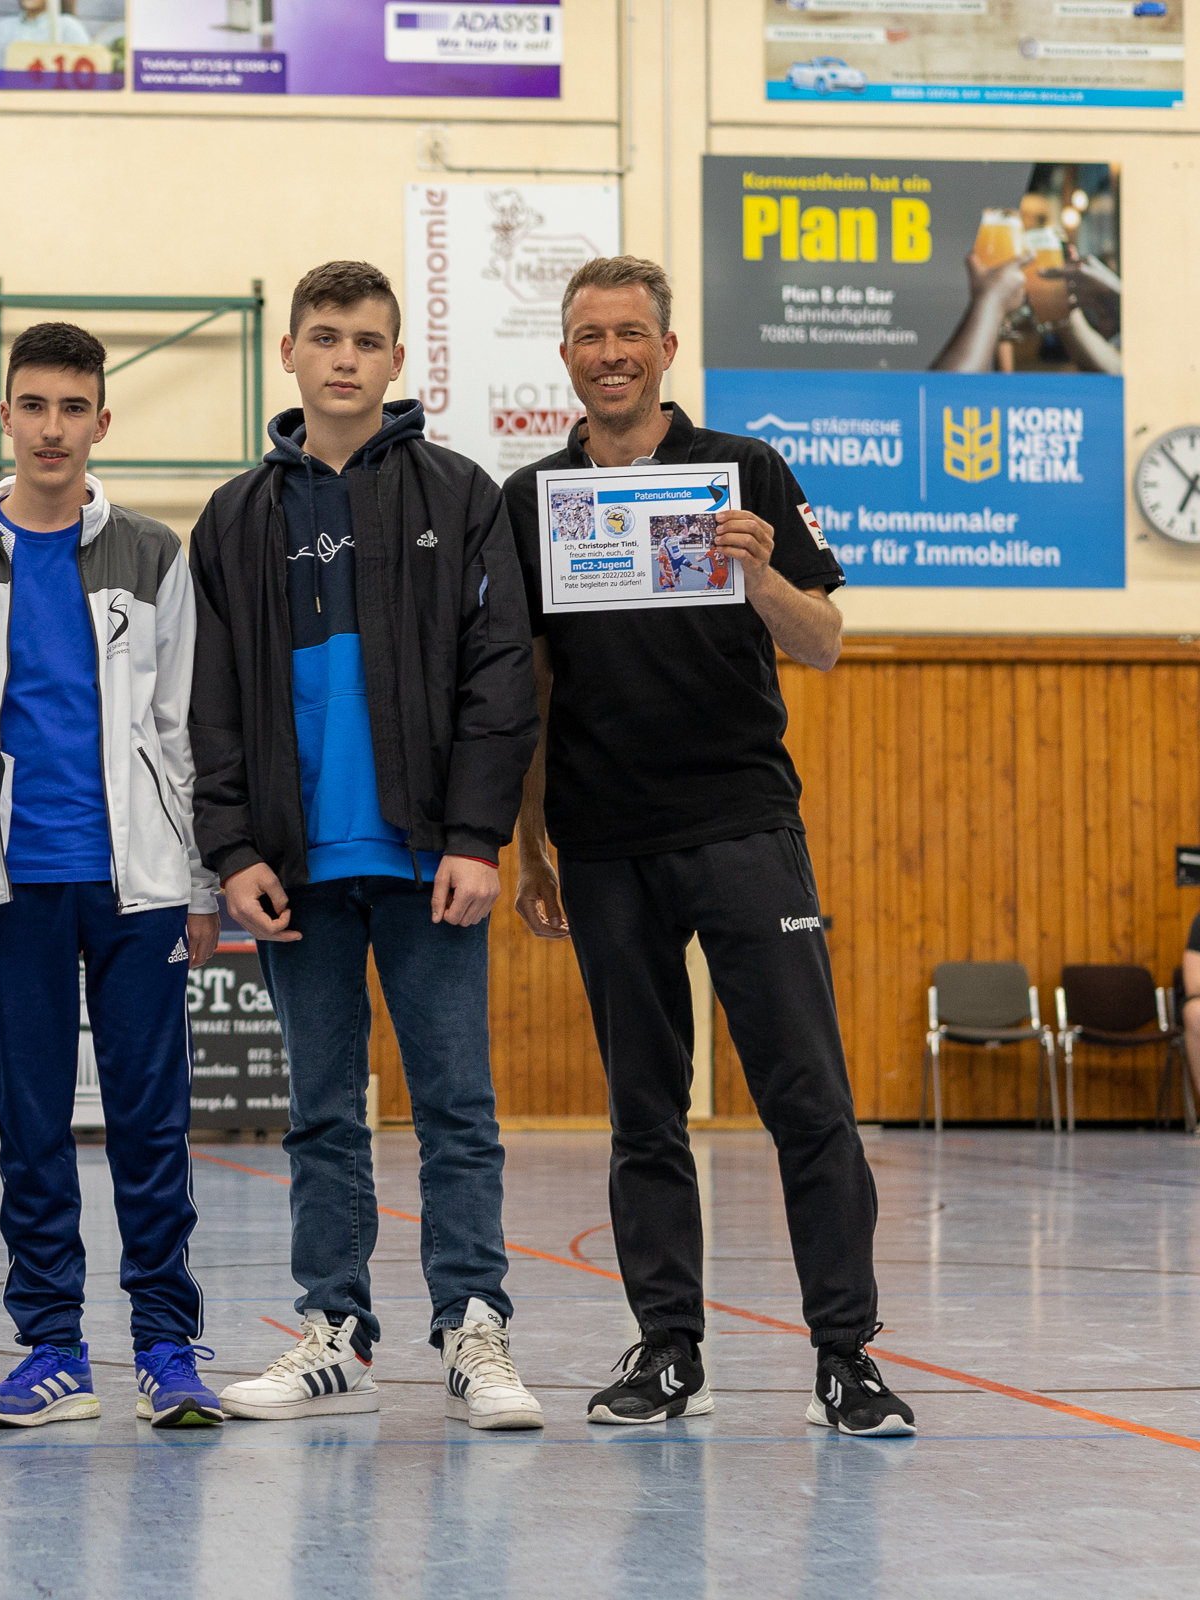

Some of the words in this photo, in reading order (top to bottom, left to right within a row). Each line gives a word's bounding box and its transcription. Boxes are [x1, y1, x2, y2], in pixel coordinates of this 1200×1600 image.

[453, 12, 540, 33] ADASYS
[743, 172, 867, 192] Kornwestheim
[871, 175, 898, 191] hat
[903, 176, 931, 193] ein
[742, 195, 878, 262] Plan
[891, 198, 933, 263] B
[420, 189, 450, 416] Gastronomie
[781, 285, 820, 303] Plan
[821, 286, 834, 303] B
[836, 286, 862, 304] die
[866, 287, 895, 304] Bar
[809, 326, 918, 345] Kornwestheim
[492, 412, 586, 434] DOMIZ
[812, 416, 901, 437] STÄDTISCHE
[1007, 407, 1084, 431] KORN
[1007, 434, 1083, 458] WEST
[1007, 457, 1084, 483] HEIM.
[634, 490, 692, 501] Patenurkunde
[814, 504, 853, 531] Ihr
[858, 505, 1018, 533] kommunaler
[564, 543, 576, 551] Ich,
[578, 542, 619, 550] Christopher
[587, 550, 605, 558] mich,
[606, 549, 624, 557] euch,
[872, 538, 910, 565] für
[914, 540, 1061, 568] Immobilien
[567, 573, 578, 581] der
[601, 570, 636, 579] 2022/2023
[572, 559, 632, 571] mC2-Jugend
[580, 581, 609, 590] begleiten
[618, 578, 642, 587] dürfen!
[780, 914, 820, 933] Kempa
